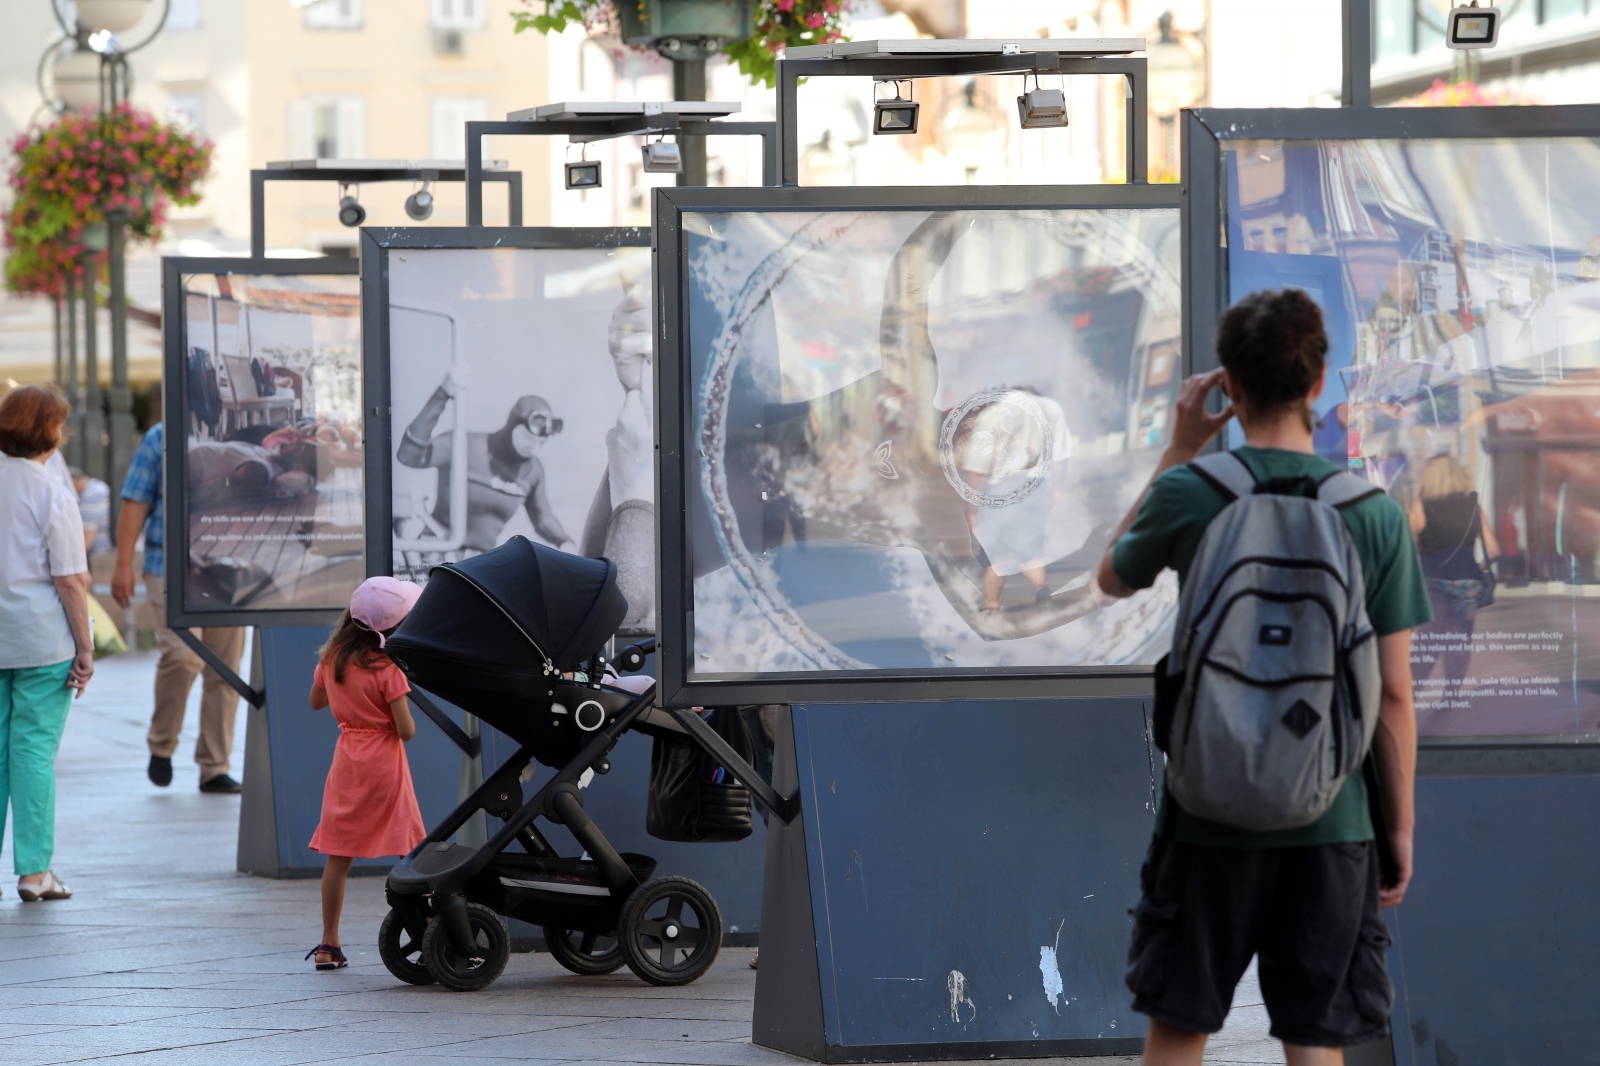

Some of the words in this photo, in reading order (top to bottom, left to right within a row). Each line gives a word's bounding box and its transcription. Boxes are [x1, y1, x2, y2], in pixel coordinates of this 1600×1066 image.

[200, 515, 212, 524] dry
[1420, 632, 1428, 640] in
[1429, 632, 1470, 641] freediving.
[1486, 631, 1512, 640] bodies
[1513, 632, 1527, 640] are
[1528, 631, 1564, 641] perfectly
[1409, 644, 1419, 652] do
[1420, 644, 1427, 652] is
[1428, 643, 1447, 651] relax
[1448, 643, 1462, 651] and
[1463, 643, 1474, 651] let
[1475, 643, 1488, 653] go.
[1489, 642, 1503, 651] this
[1541, 644, 1560, 653] easy
[1422, 654, 1437, 663] life.
[1418, 677, 1451, 688] ronjenju
[1462, 677, 1479, 685] dah.
[1480, 677, 1498, 685] naša
[1499, 676, 1519, 686] tijela
[1530, 675, 1560, 684] idealno
[1458, 688, 1498, 699] prepustiti.
[1524, 687, 1538, 696] čini
[1540, 687, 1558, 696] lako,
[1431, 699, 1450, 710] cijeli
[1451, 699, 1472, 709] život.
